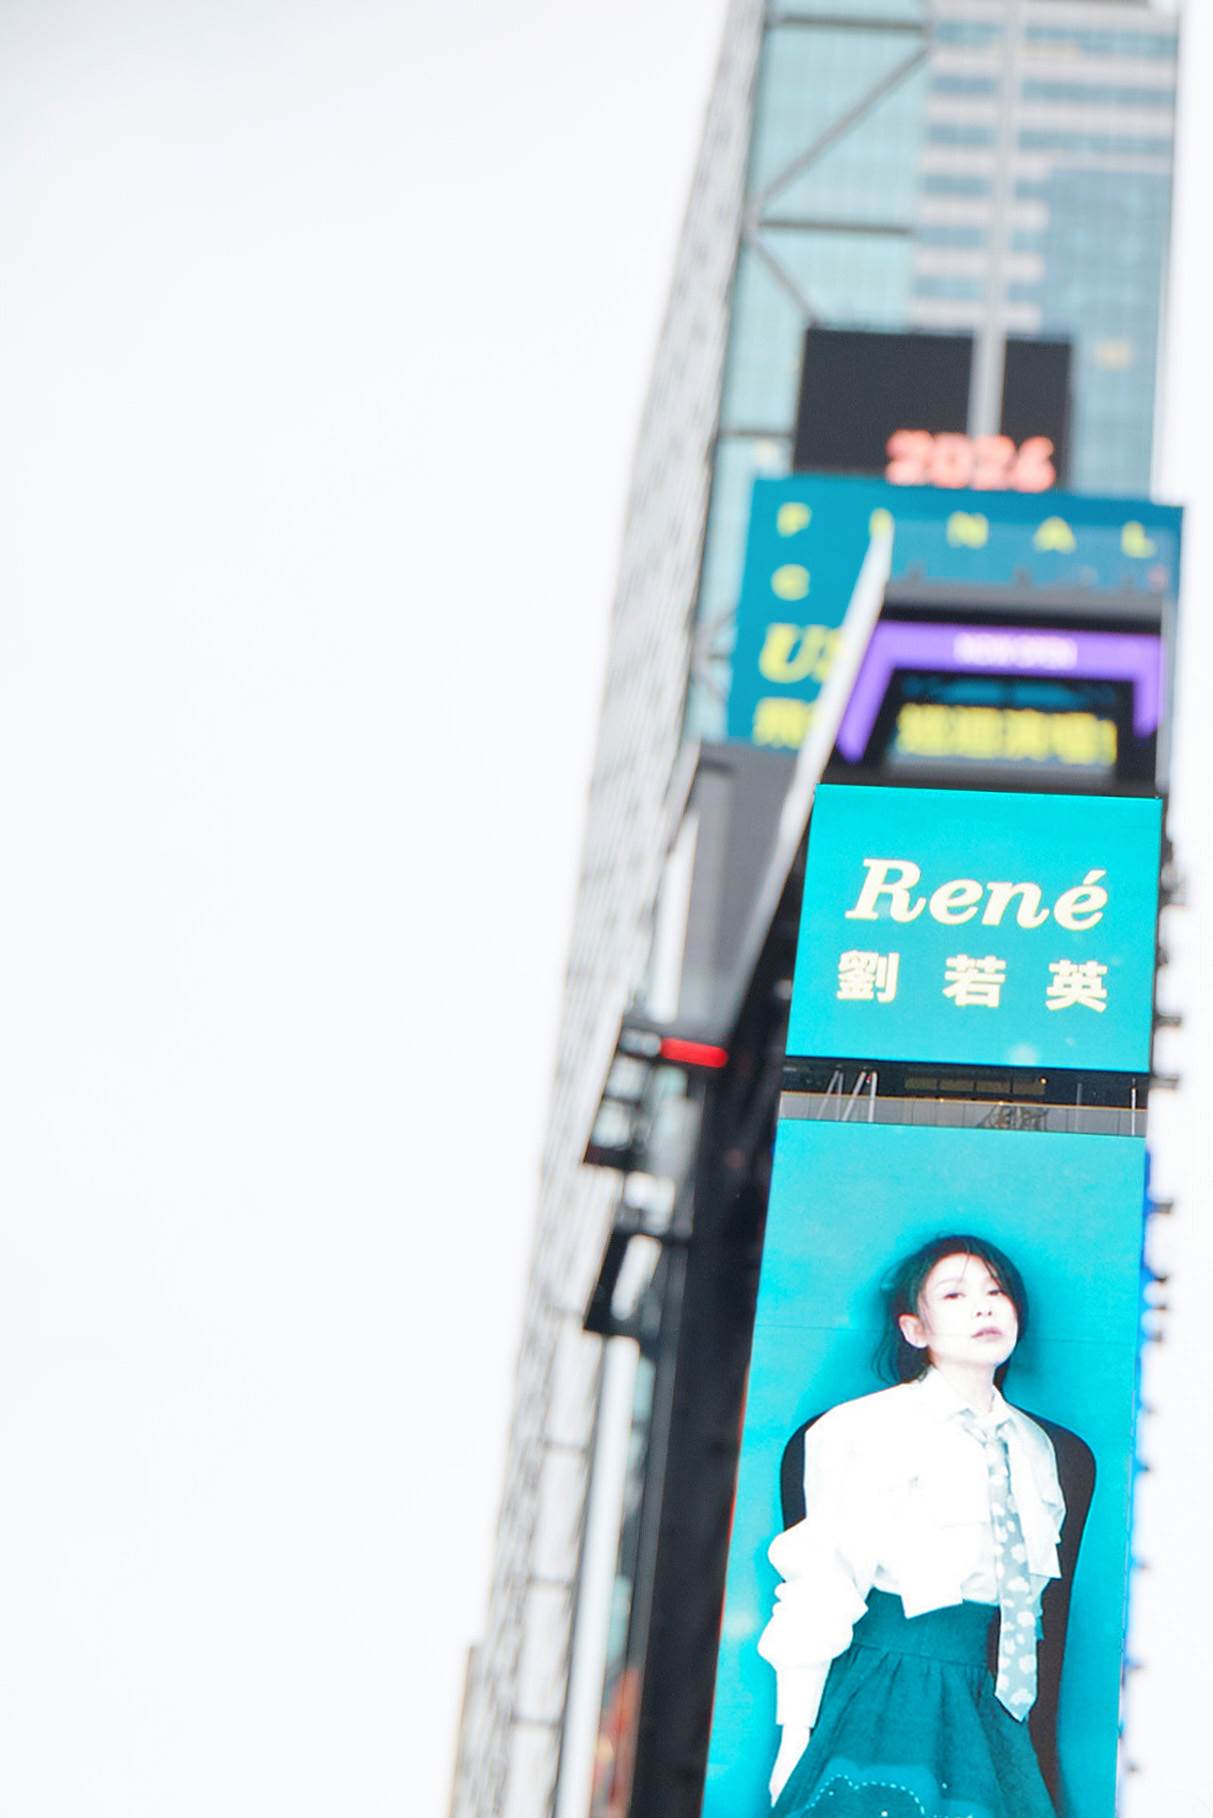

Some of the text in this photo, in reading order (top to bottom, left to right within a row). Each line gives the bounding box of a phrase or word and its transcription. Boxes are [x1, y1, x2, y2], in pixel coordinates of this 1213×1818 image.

[844, 858, 1109, 931] René
[836, 949, 1109, 1013] 劉若英
